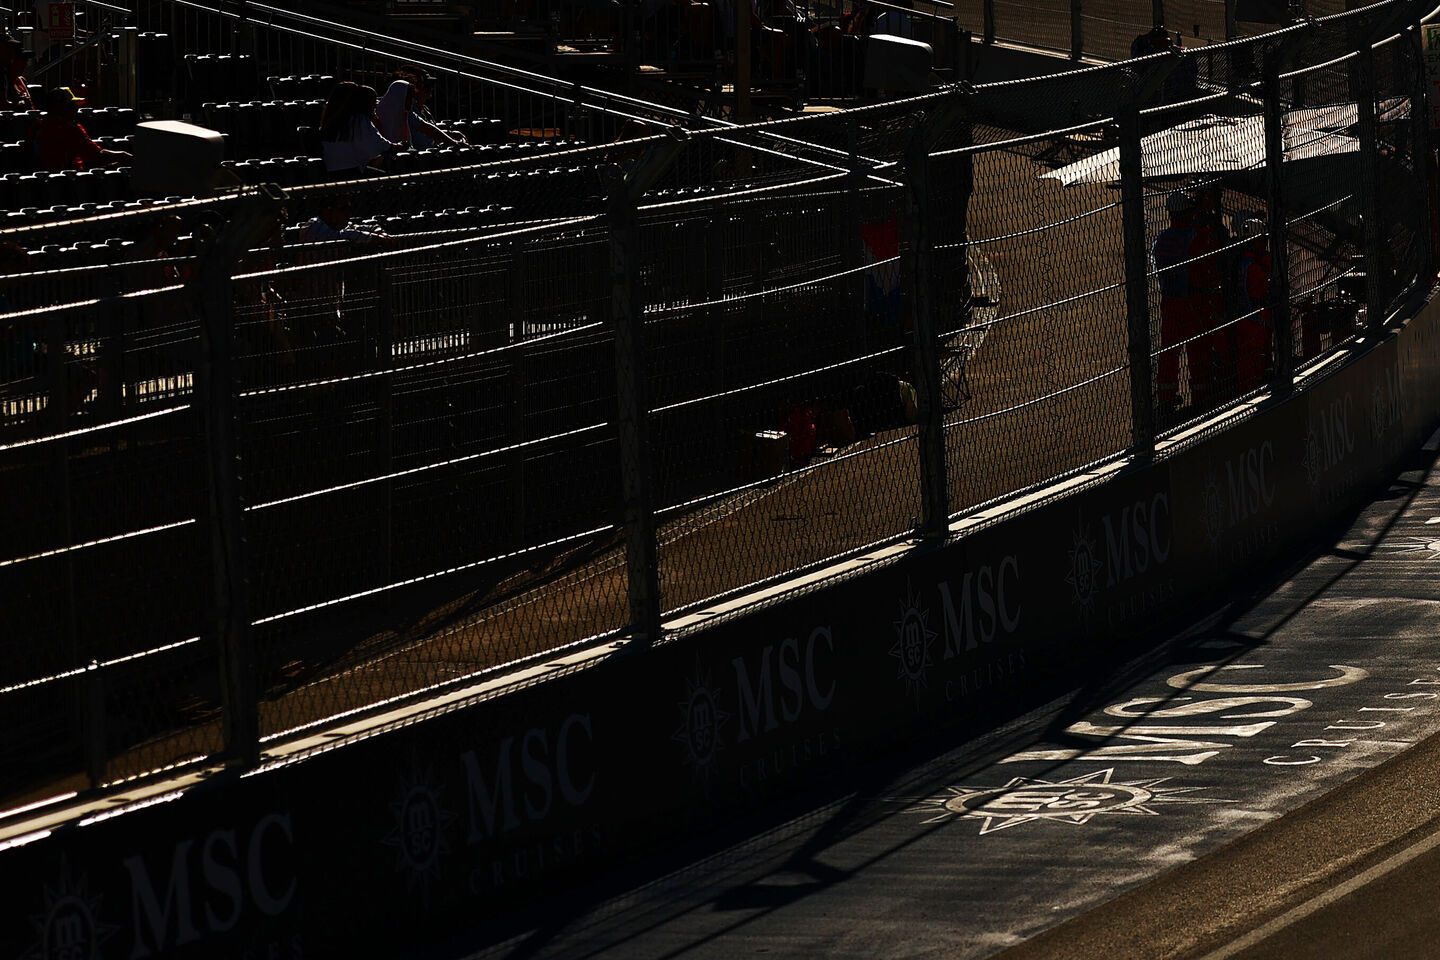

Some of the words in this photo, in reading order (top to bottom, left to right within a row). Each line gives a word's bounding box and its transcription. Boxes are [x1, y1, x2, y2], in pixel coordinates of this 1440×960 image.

[1226, 439, 1276, 526] MSC
[1102, 492, 1171, 588] MSC
[937, 553, 1024, 660] MSC
[731, 625, 838, 743] MSC
[998, 664, 1371, 765] MSC
[459, 712, 598, 846] MSC
[122, 810, 298, 960] MSC
